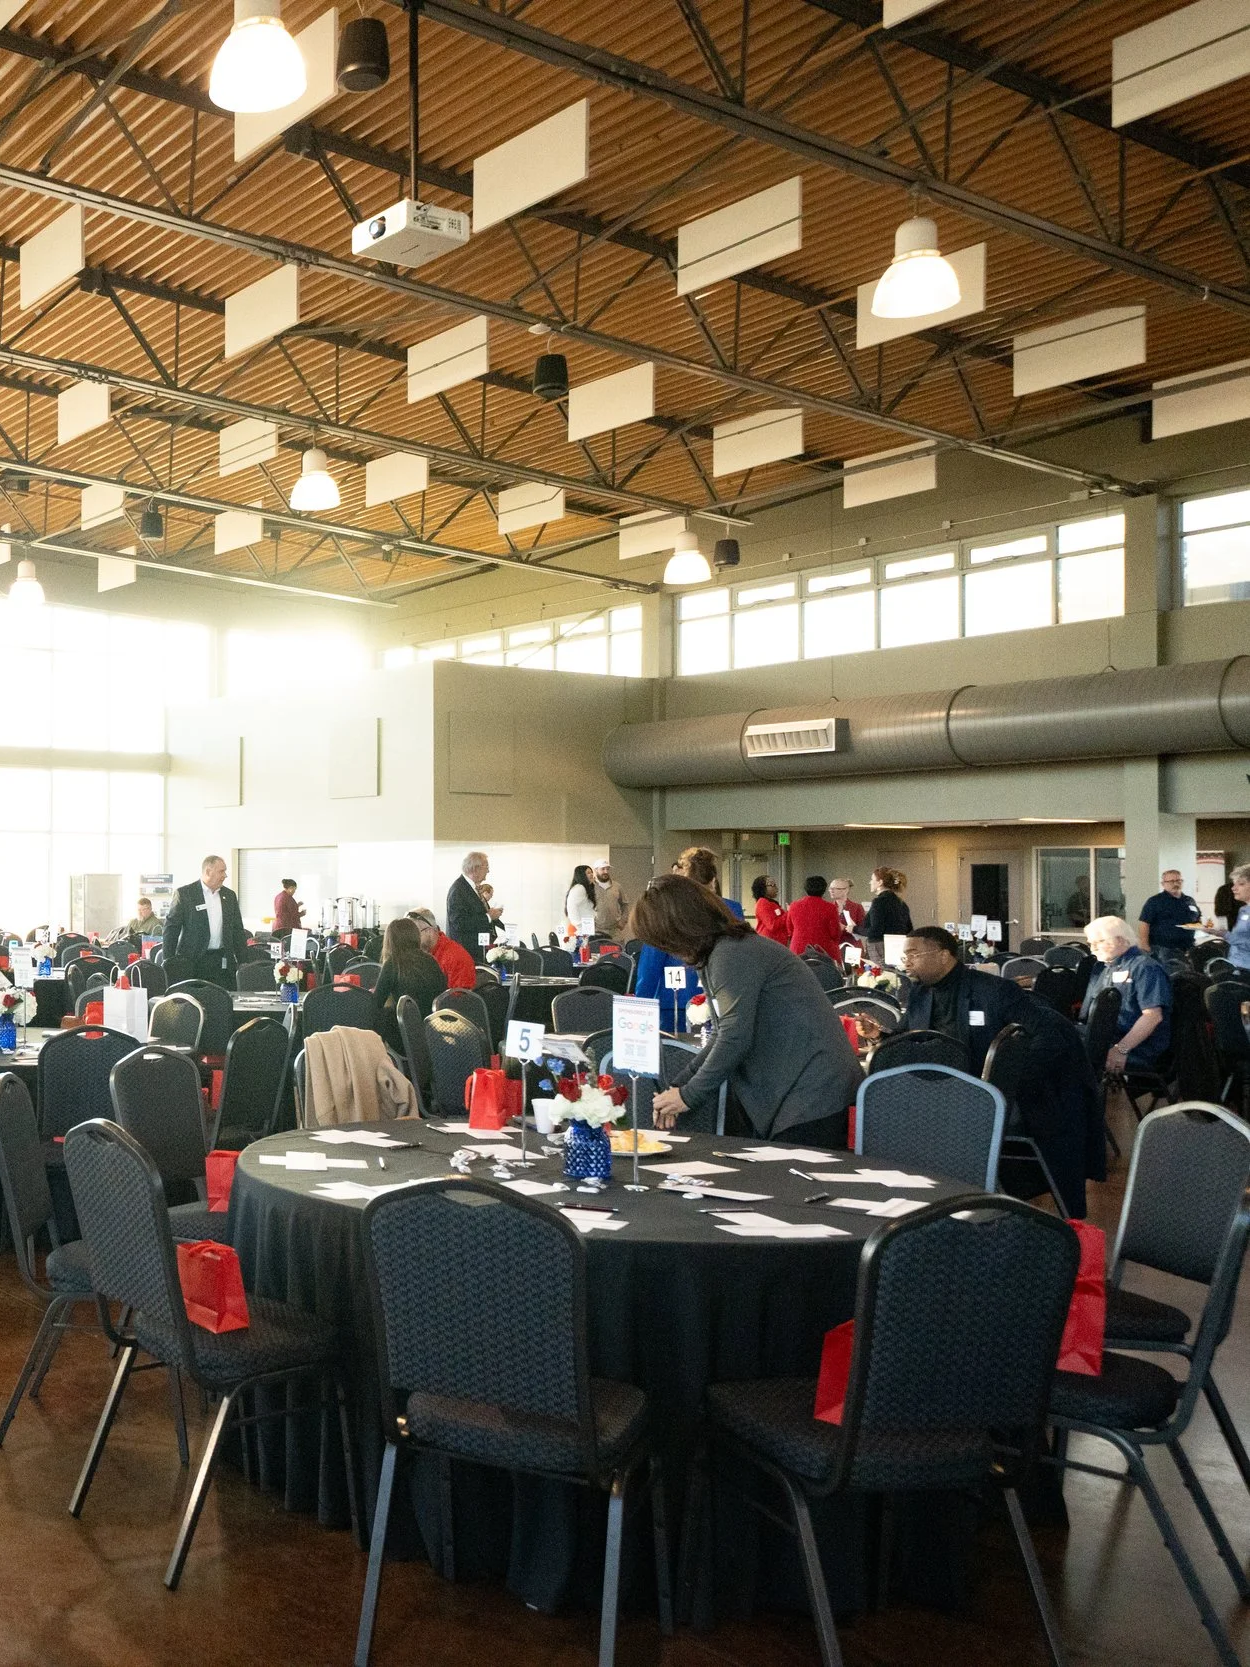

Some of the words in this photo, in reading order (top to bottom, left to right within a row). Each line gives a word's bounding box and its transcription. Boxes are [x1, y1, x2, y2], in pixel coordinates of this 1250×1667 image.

[668, 969, 682, 985] 14
[617, 1016, 655, 1035] Google
[519, 1028, 531, 1053] 5
